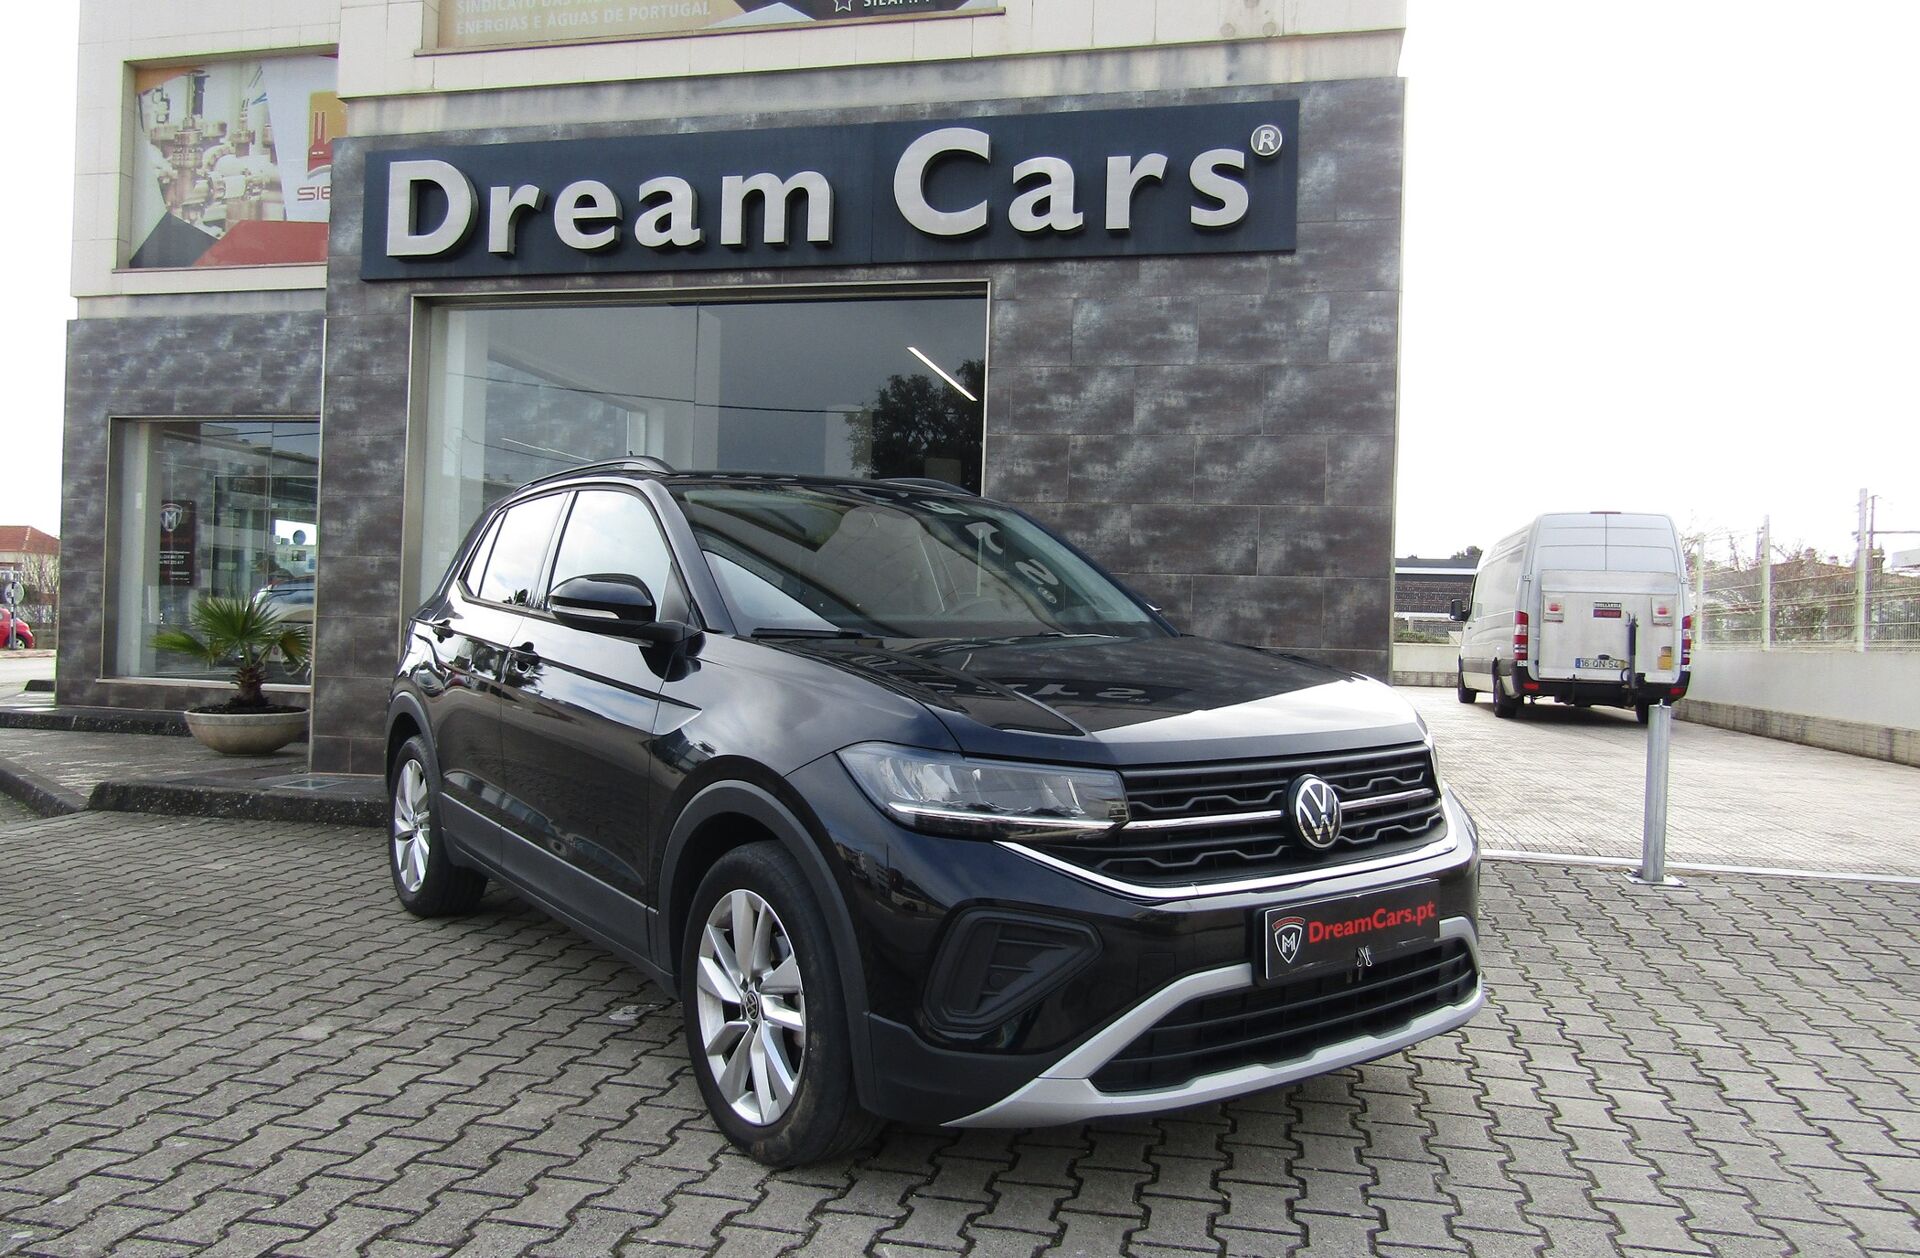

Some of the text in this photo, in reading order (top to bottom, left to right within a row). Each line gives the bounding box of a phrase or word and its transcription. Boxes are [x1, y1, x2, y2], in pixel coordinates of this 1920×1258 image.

[456, 15, 529, 35] ENERGIAS
[534, 15, 542, 29] E
[604, 8, 624, 23] DE
[629, 2, 709, 21] PORTUGAL
[386, 159, 833, 258] Dream
[893, 126, 1250, 236] Cars
[1308, 901, 1437, 943] DreamCars.pt
